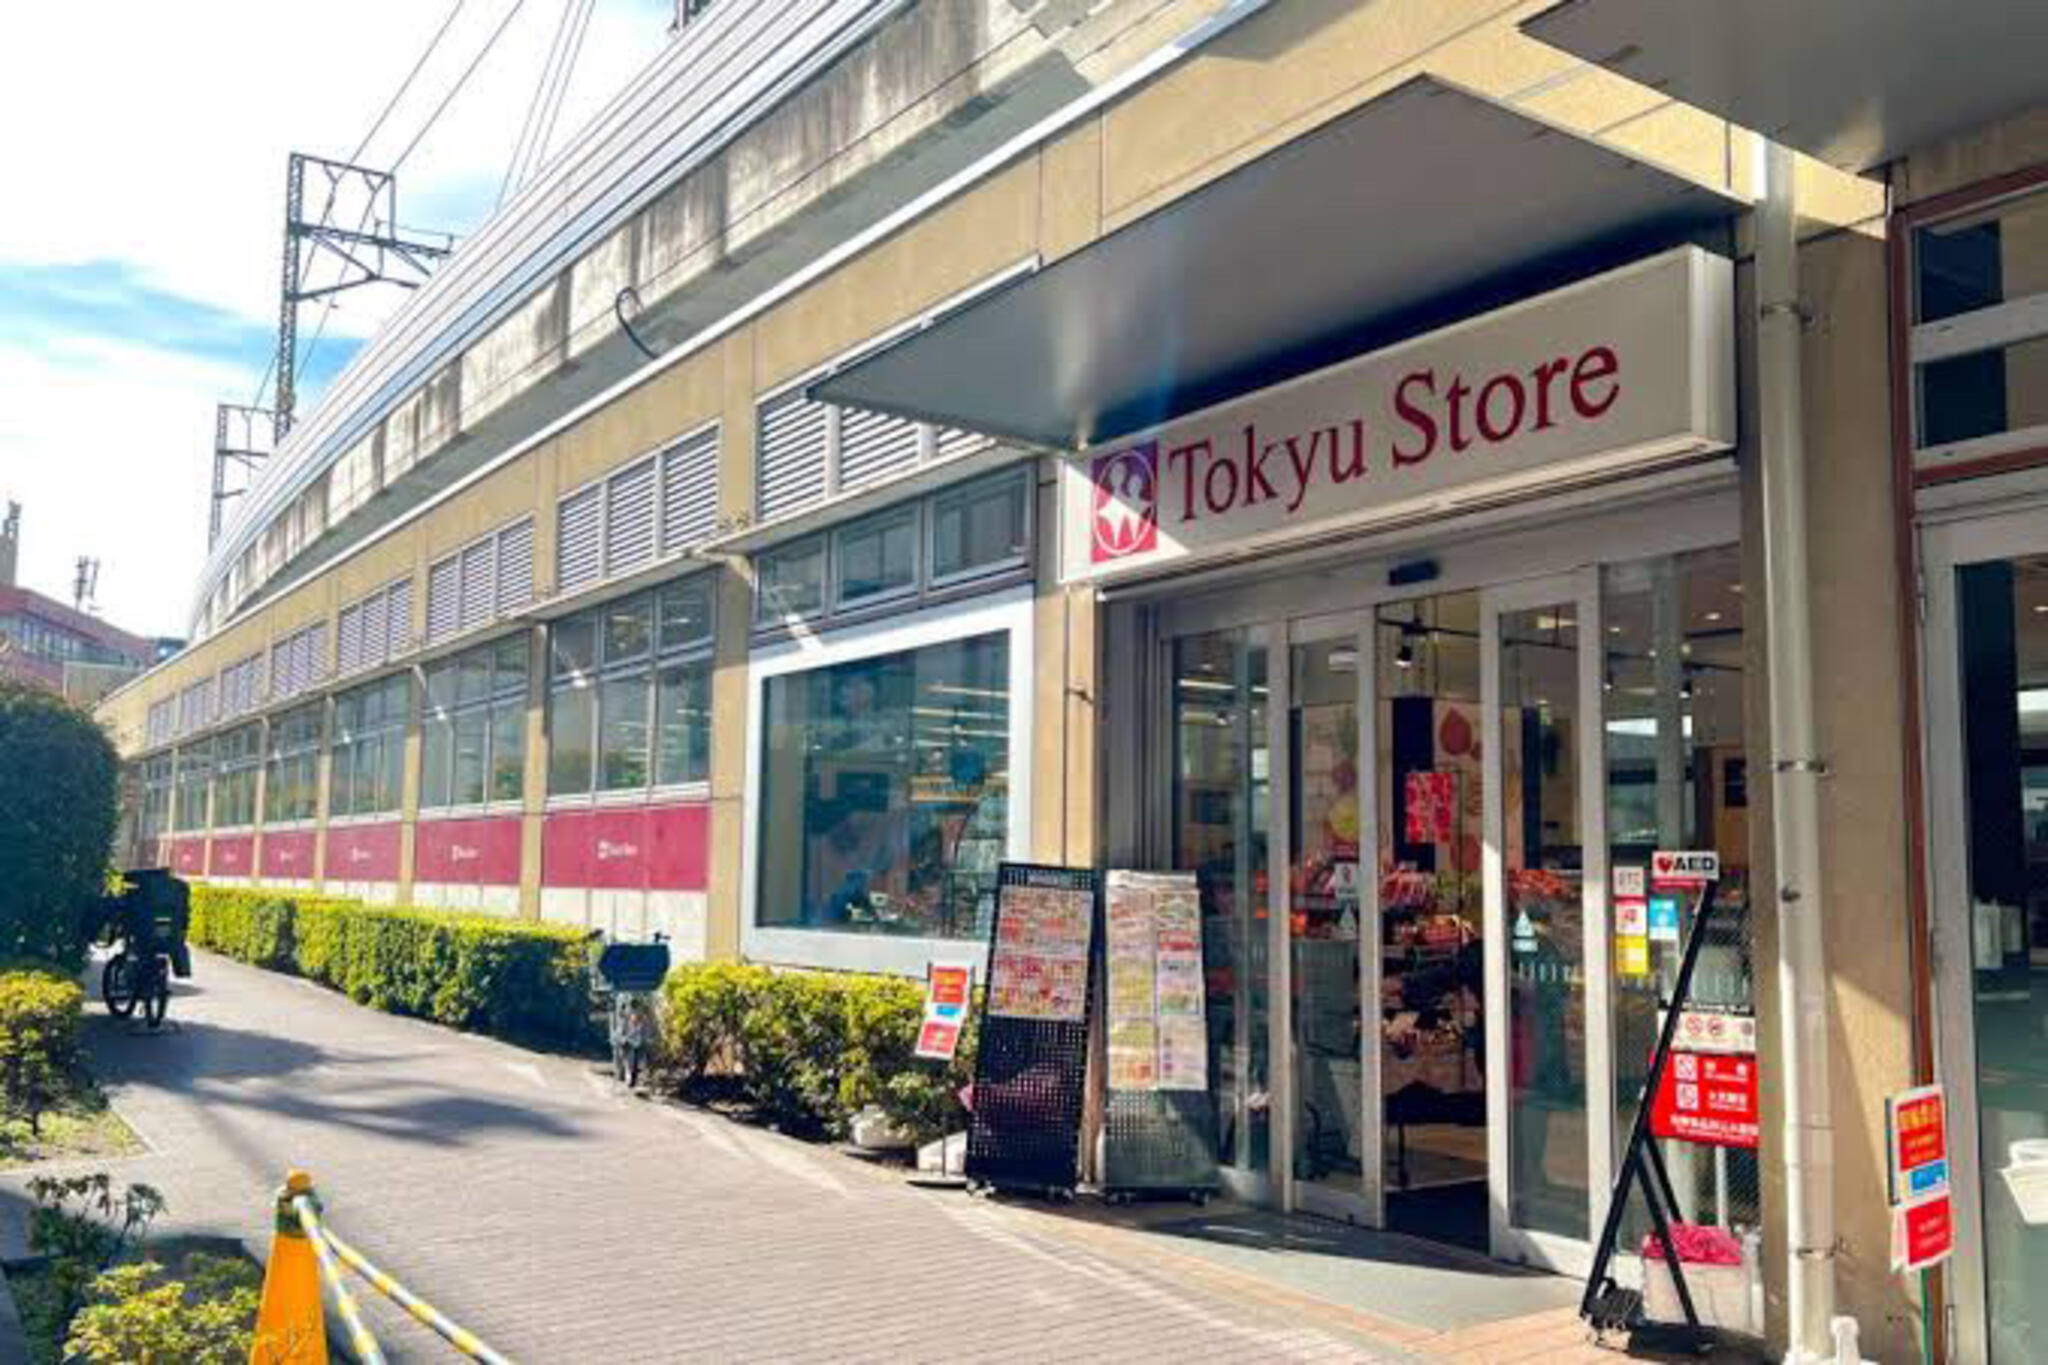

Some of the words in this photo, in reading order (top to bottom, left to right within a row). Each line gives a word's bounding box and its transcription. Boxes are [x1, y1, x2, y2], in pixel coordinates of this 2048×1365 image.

[1167, 417, 1367, 523] Tokyu
[1390, 345, 1620, 469] Store
[1675, 856, 1716, 871] AED
